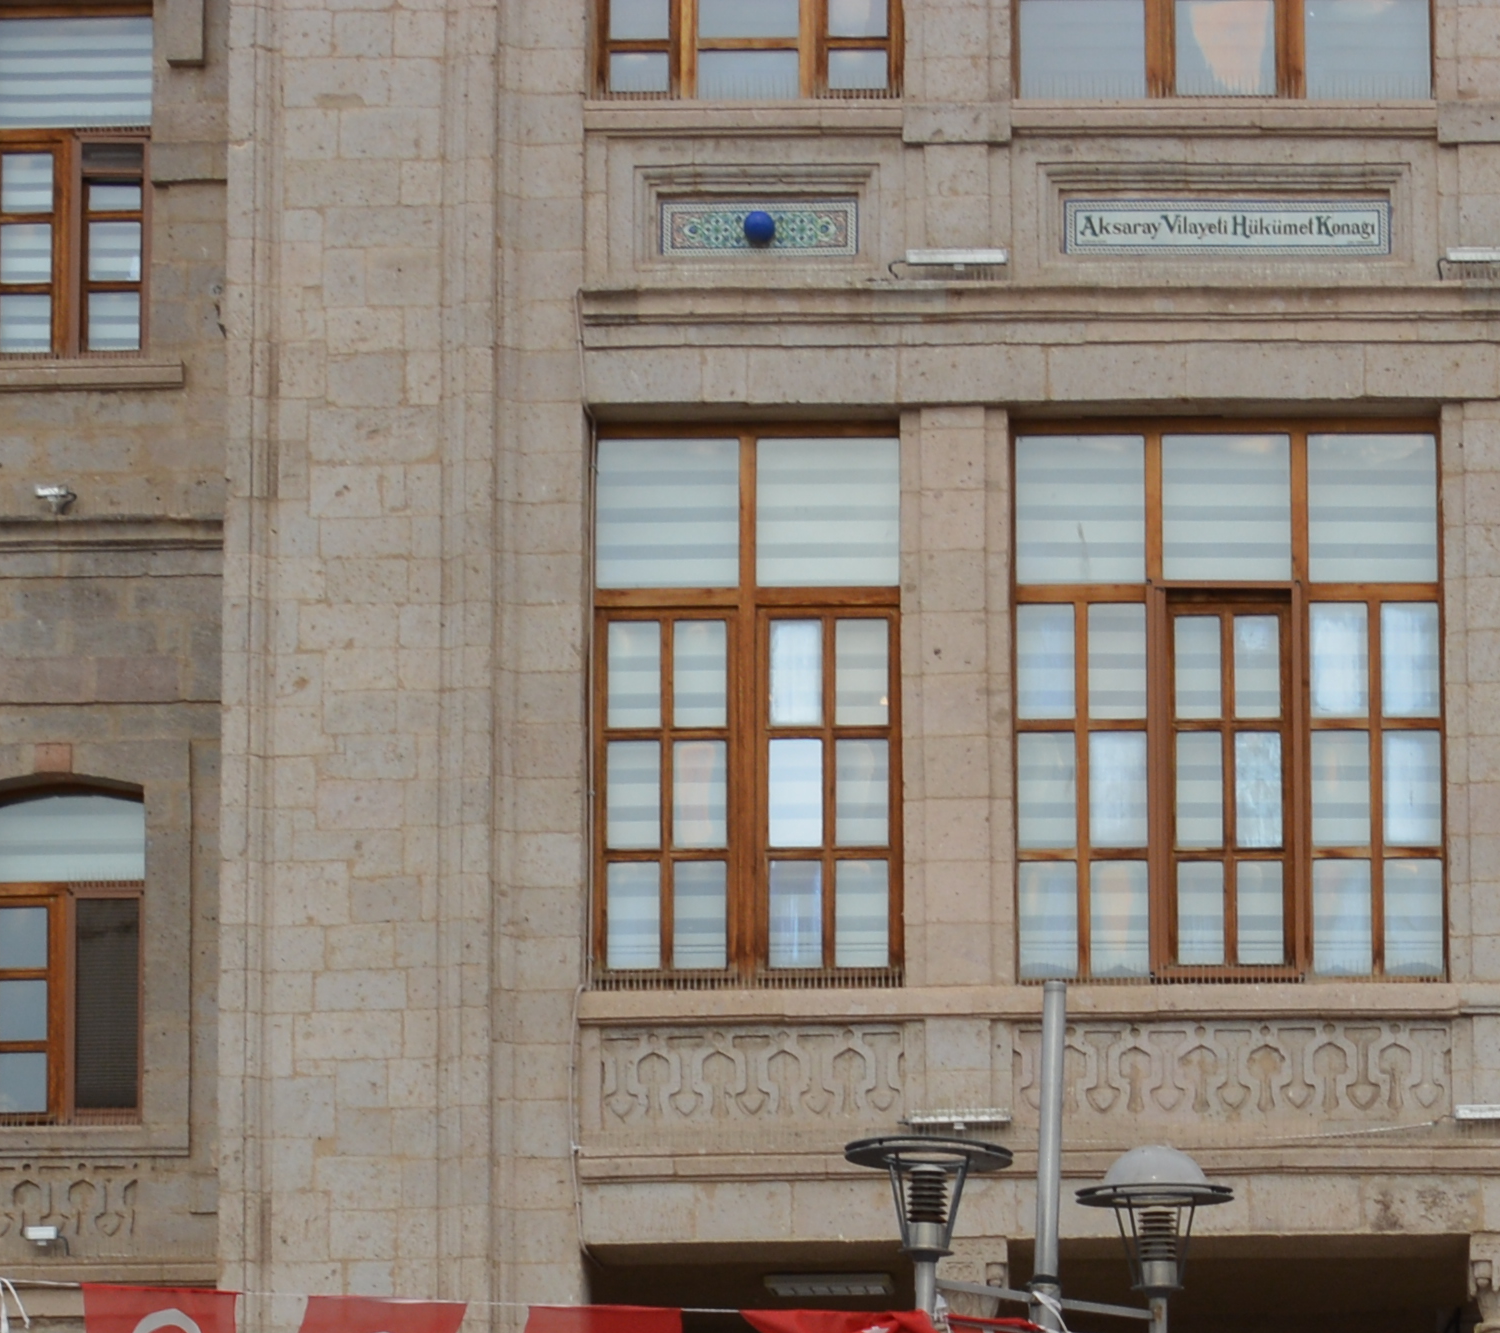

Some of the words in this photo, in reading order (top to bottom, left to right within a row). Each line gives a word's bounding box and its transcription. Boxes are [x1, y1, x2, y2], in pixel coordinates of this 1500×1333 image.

[1079, 214, 1161, 239] Aksaray
[1161, 213, 1228, 239] Vilayeti
[1232, 213, 1313, 239] Hükümet
